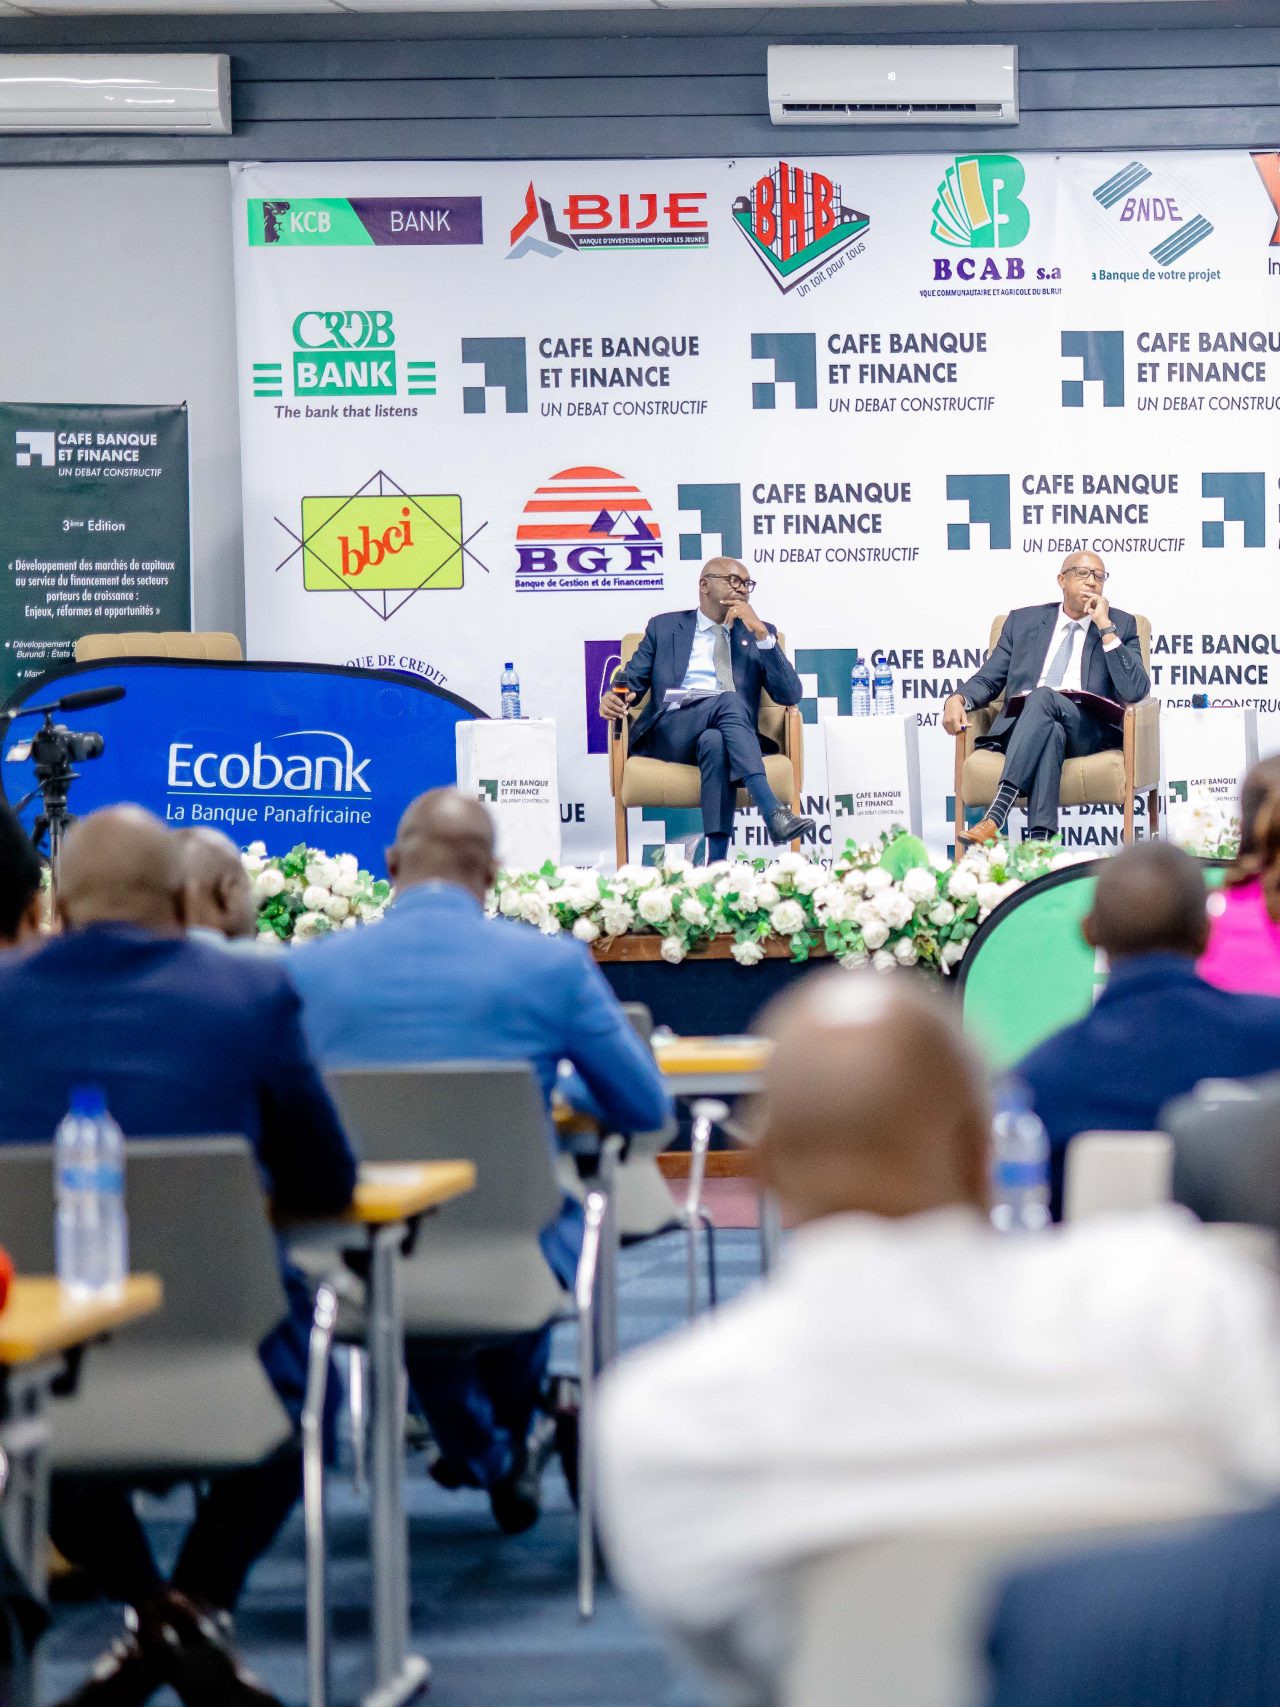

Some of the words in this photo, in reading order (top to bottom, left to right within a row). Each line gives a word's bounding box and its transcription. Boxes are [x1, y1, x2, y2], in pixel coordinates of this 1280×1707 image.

[290, 210, 331, 233] KCB
[390, 208, 451, 232] BANK
[563, 192, 708, 230] BIJE
[756, 161, 836, 262] BHB
[1119, 197, 1183, 222] BNDE
[796, 285, 811, 297] Un
[810, 270, 827, 287] toit
[825, 256, 846, 278] pour
[845, 242, 866, 260] tous
[933, 257, 1026, 281] BCAB
[1099, 269, 1140, 283] Banque
[1142, 268, 1156, 280] de
[1158, 270, 1186, 280] votre
[1188, 268, 1221, 282] projet
[292, 310, 395, 350] CRDB
[539, 337, 592, 358] CAFE
[602, 336, 700, 358] BANQUE
[827, 334, 881, 355] CAFE
[890, 332, 987, 354] BANQUE
[1136, 332, 1189, 352] CAFE
[297, 361, 394, 390] BANK
[540, 367, 562, 388] ET
[570, 366, 670, 387] FINANCE
[828, 364, 851, 384] ET
[859, 363, 958, 384] FINANCE
[1138, 363, 1160, 383] ET
[1168, 362, 1266, 383] FINANCE
[273, 404, 302, 419] The
[305, 403, 338, 418] bank
[342, 403, 371, 418] that
[374, 402, 419, 418] listens
[540, 401, 562, 417] UN
[566, 401, 610, 417] DEBAT
[613, 400, 708, 416] CONSTRUCTIF
[1137, 396, 1158, 412] UN
[1162, 396, 1205, 411] DEBAT
[57, 433, 92, 446] CAFE
[96, 432, 158, 448] BANQUE
[58, 449, 75, 462] ET
[78, 449, 139, 462] FINANCE
[752, 483, 806, 505] CAFE
[815, 482, 912, 504] BANQUE
[1022, 474, 1074, 496] CAFE
[1083, 473, 1179, 497] BANQUE
[753, 514, 776, 535] ET
[784, 513, 882, 535] FINANCE
[1023, 504, 1044, 525] ET
[1052, 503, 1149, 525] FINANCE
[87, 519, 126, 532] Edition
[338, 507, 414, 577] bbci
[15, 559, 77, 574] Développement
[79, 559, 93, 571] des
[95, 559, 128, 571] marchés
[129, 559, 140, 571] de
[141, 559, 175, 573] capitaux
[515, 546, 664, 574] BGF
[15, 578, 26, 586] au
[28, 574, 56, 586] service
[57, 574, 68, 586] du
[70, 574, 120, 586] financement
[121, 574, 135, 586] des
[137, 575, 169, 586] secteurs
[515, 579, 545, 589] Banque
[547, 578, 556, 587] de
[559, 578, 589, 587] Gestion
[591, 578, 599, 587] et
[601, 577, 611, 586] de
[614, 577, 664, 586] Financement
[46, 591, 80, 603] porteurs
[82, 589, 92, 601] de
[94, 590, 134, 601] croissance
[25, 605, 54, 619] Enjeux,
[57, 604, 93, 617] réformes
[94, 606, 102, 616] et
[104, 604, 154, 618] opportunités
[1170, 665, 1269, 685] FINANCE
[167, 730, 372, 792] Ecobank
[166, 804, 185, 821] La
[191, 804, 259, 824] Banque
[264, 805, 372, 824] Panafricaine
